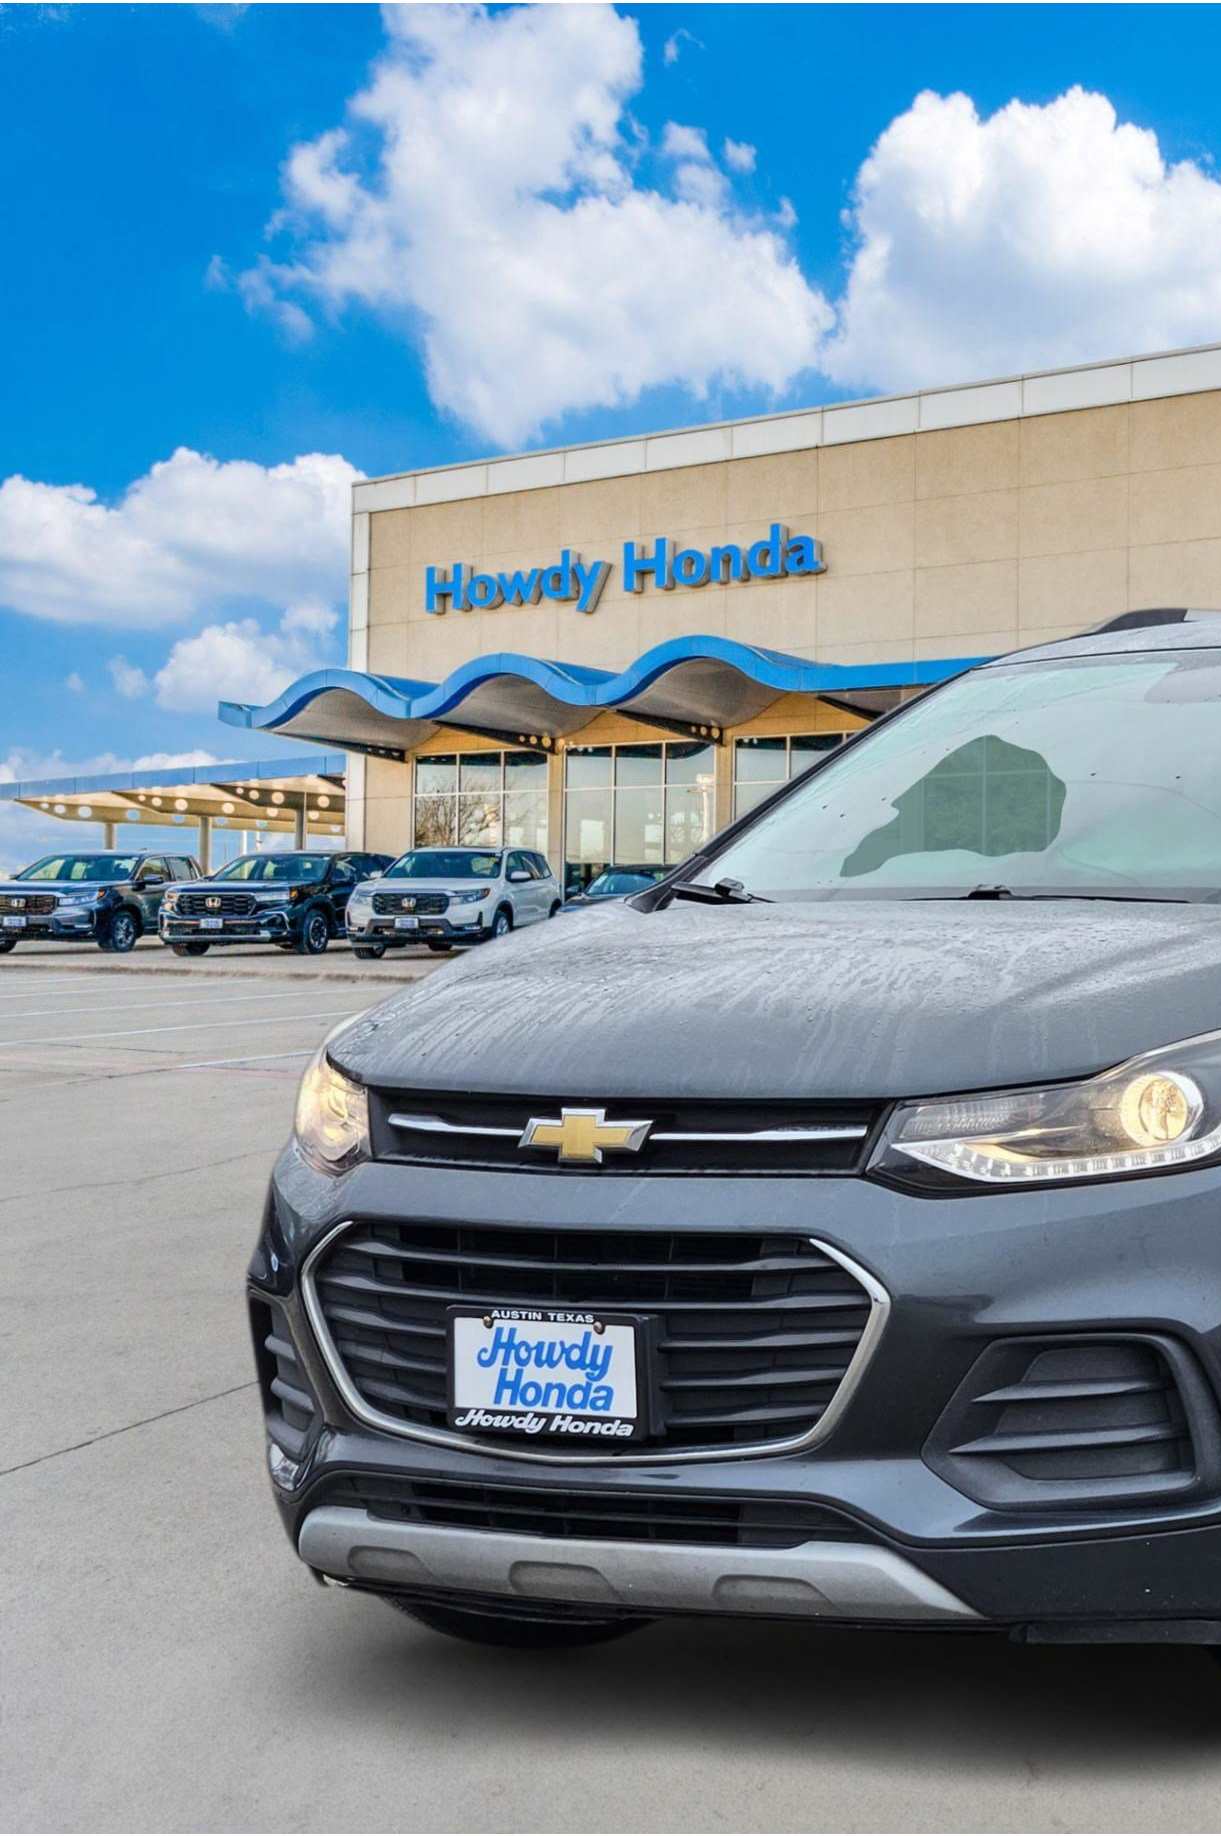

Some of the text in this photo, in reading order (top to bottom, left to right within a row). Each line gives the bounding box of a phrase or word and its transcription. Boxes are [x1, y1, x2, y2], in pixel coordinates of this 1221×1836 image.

[425, 523, 826, 614] Howdy Honda
[491, 1310, 594, 1324] AUSTIN TEXAS
[476, 1326, 613, 1382] Howdy
[493, 1368, 614, 1412] Honda
[455, 1409, 634, 1437] Howdy Honda
